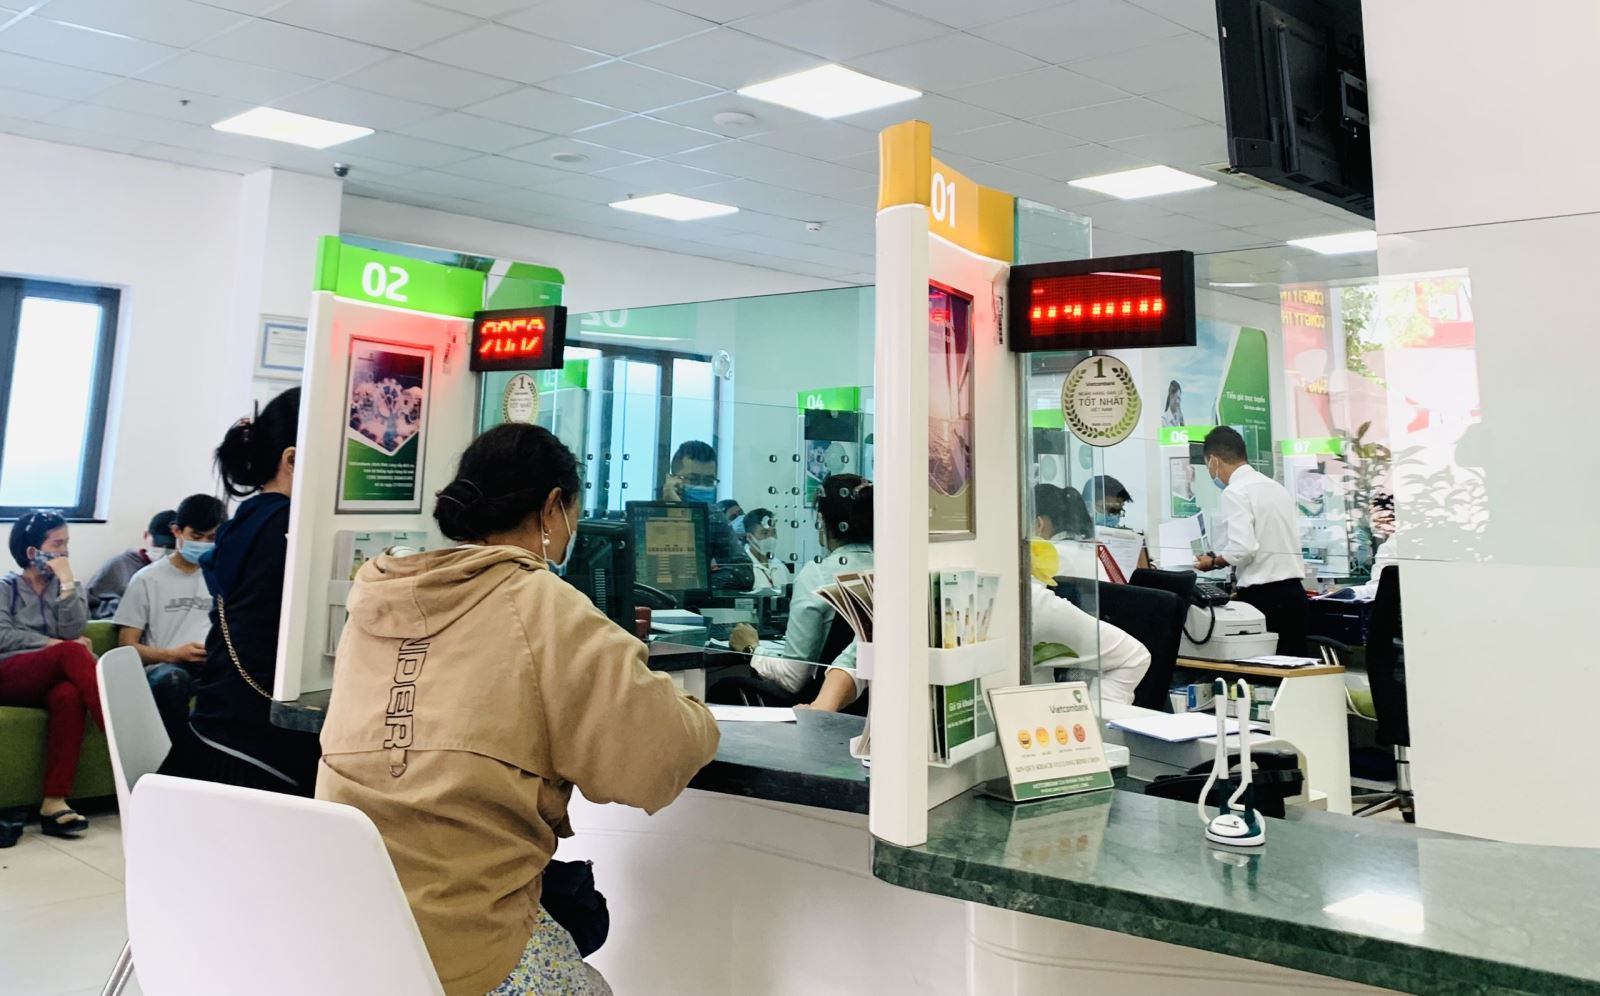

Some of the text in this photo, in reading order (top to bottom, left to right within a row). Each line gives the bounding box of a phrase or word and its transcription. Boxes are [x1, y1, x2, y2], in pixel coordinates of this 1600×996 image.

[931, 172, 956, 229] 01
[362, 262, 408, 302] 02
[1093, 358, 1107, 378] 1
[518, 375, 526, 390] 1
[806, 394, 825, 410] 04
[1079, 395, 1096, 406] TỐT
[1171, 431, 1188, 442] 06
[1049, 703, 1089, 714] Vietcombank
